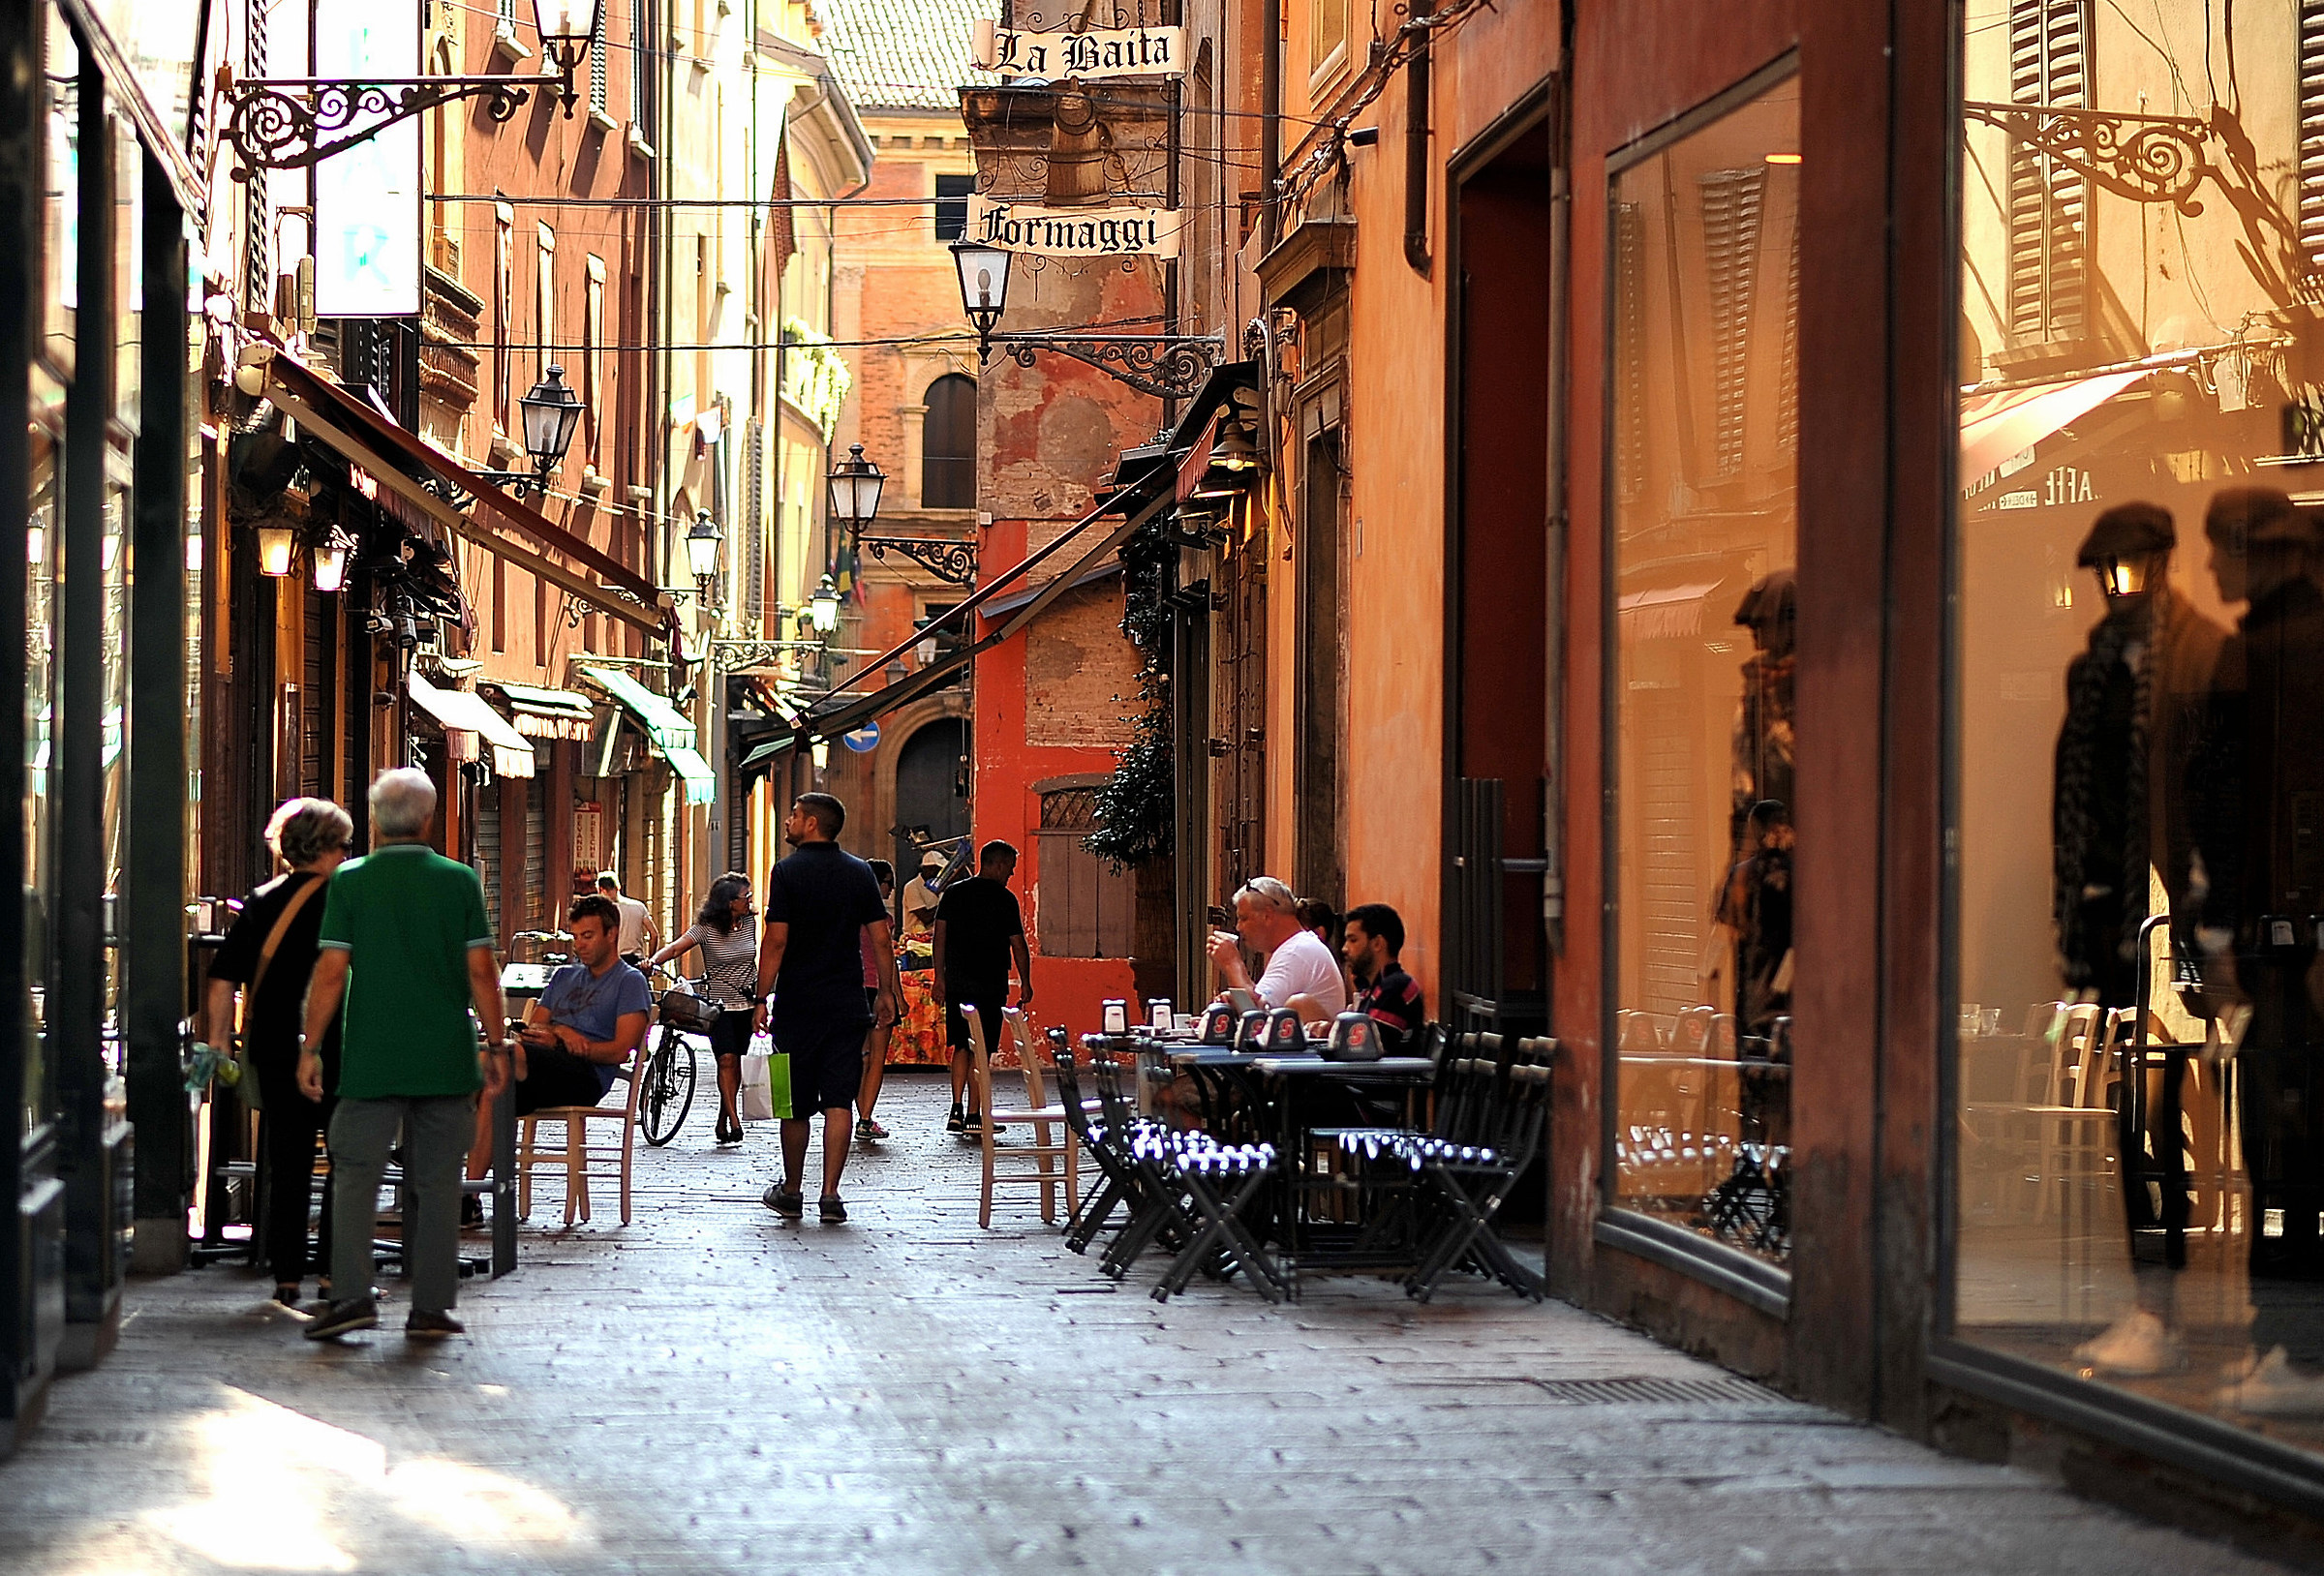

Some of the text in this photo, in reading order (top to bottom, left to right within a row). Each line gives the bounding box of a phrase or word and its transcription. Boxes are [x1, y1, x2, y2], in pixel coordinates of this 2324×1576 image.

[993, 31, 1171, 77] La Baita
[976, 205, 1158, 253] Formaggi
[1348, 1022, 1367, 1046] S
